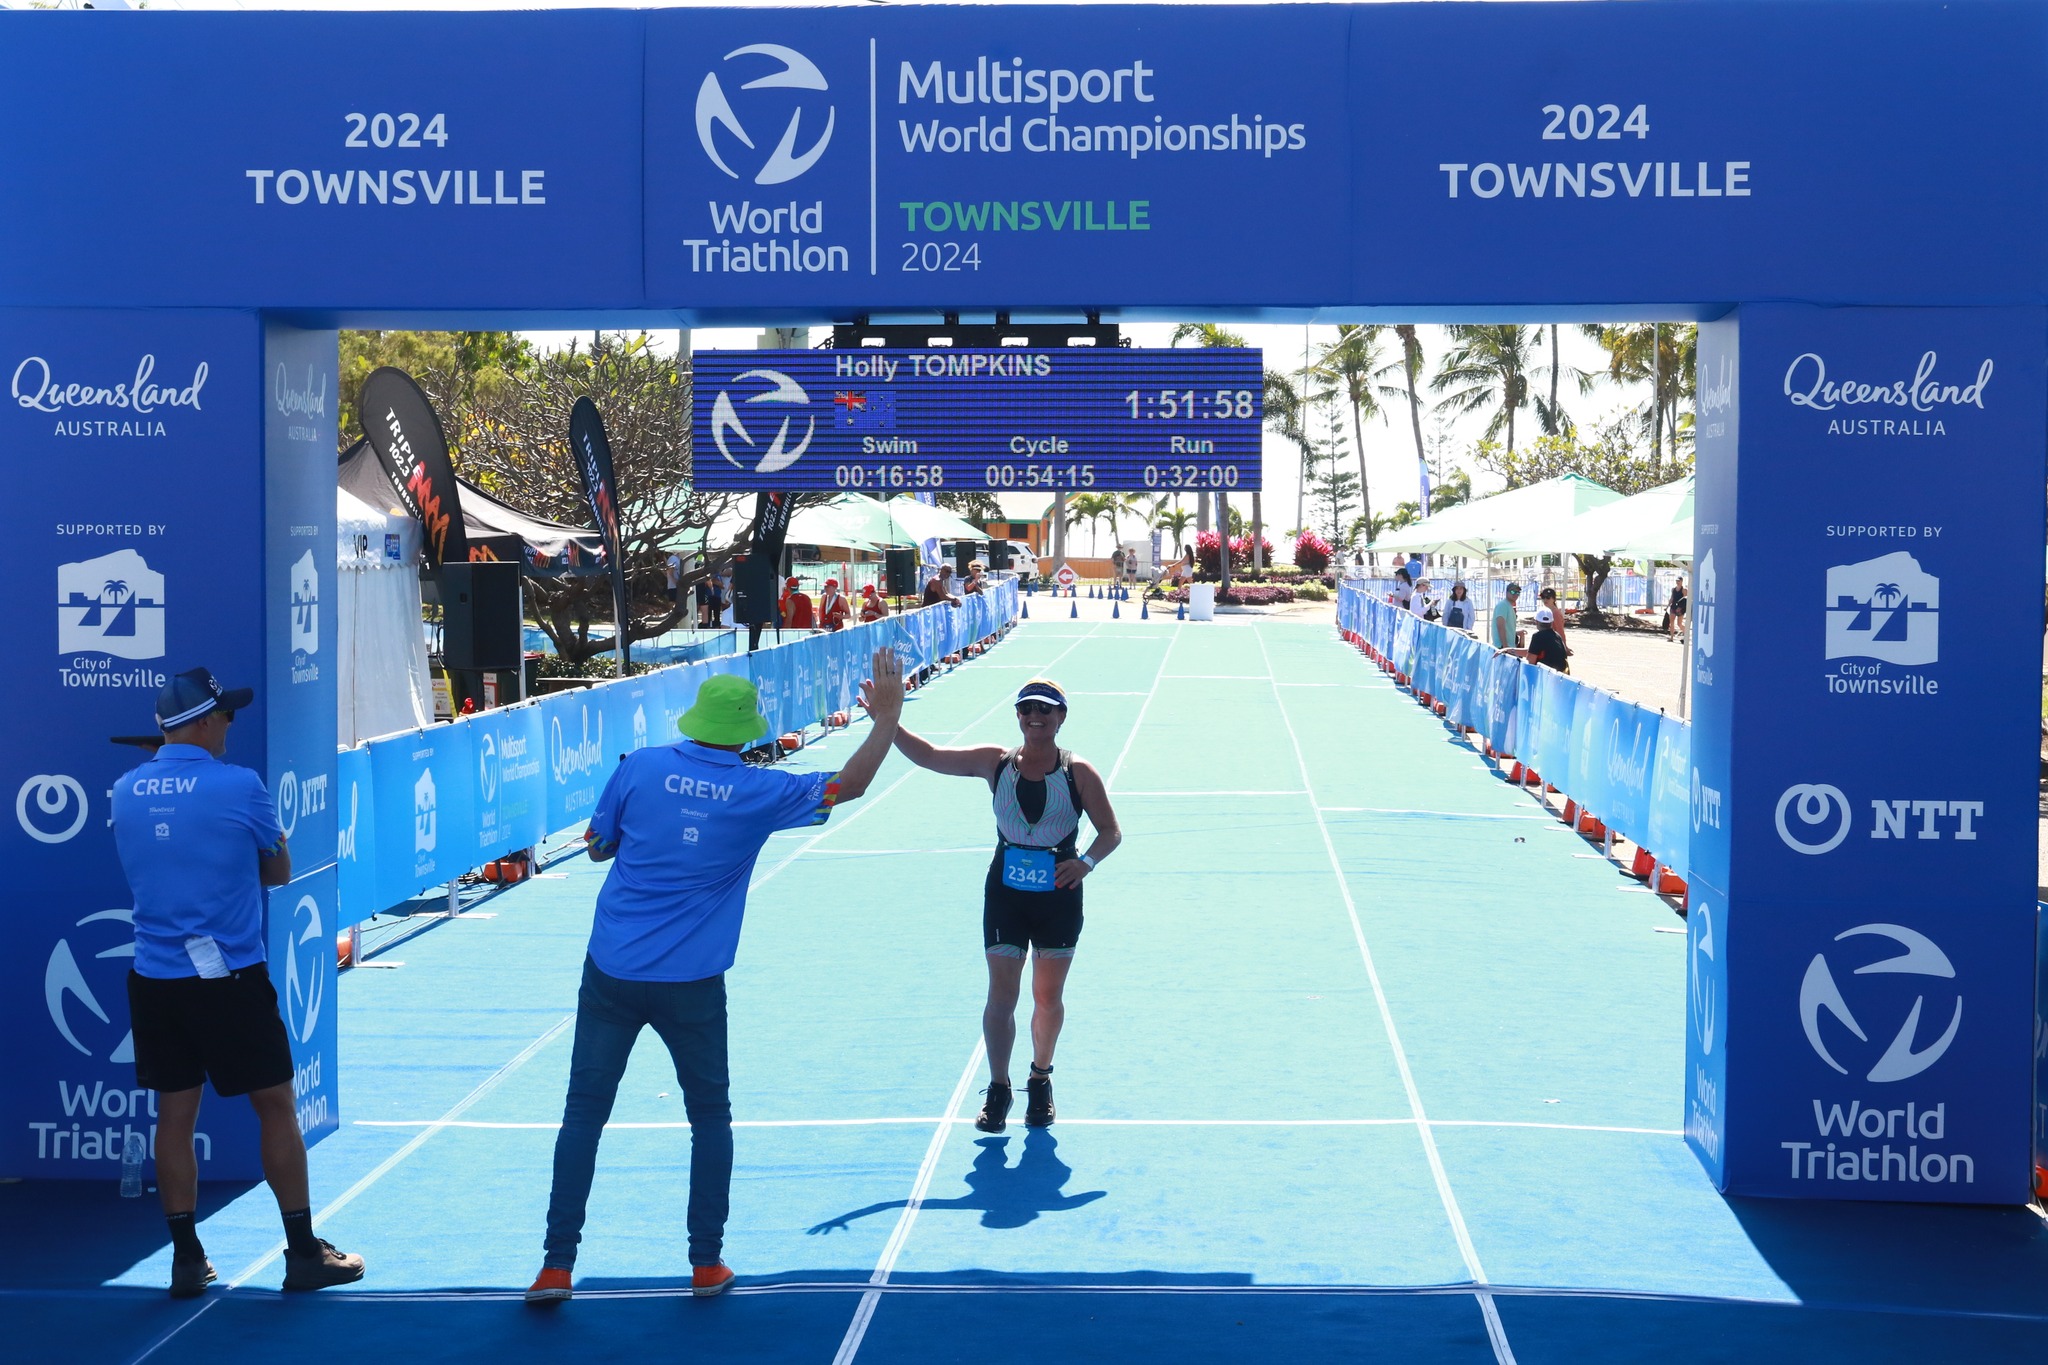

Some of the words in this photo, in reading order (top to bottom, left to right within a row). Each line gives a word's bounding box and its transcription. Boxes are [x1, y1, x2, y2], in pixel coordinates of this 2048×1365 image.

[898, 56, 1155, 113] Multisport
[344, 112, 448, 148] 2024
[899, 117, 1012, 154] World
[1022, 113, 1306, 160] Championships
[1542, 104, 1649, 140] 2024
[246, 169, 546, 206] TOWNSVILLE
[1439, 161, 1751, 199] TOWNSVILLE
[709, 200, 822, 235] World
[900, 200, 1151, 232] TOWNSVILLE
[683, 238, 849, 273] Triathlon
[901, 242, 982, 272] 2024
[835, 354, 898, 383] Holly
[908, 354, 1051, 377] TOMPKINS
[1783, 350, 1994, 413] Queensland
[11, 353, 209, 415] Queensland
[275, 362, 327, 420] Queensland
[1700, 354, 1733, 417] Queensland
[1125, 390, 1254, 420] 1:51:58
[54, 420, 167, 437] AUSTRALIA
[288, 425, 317, 441] AUSTRALIA
[1827, 420, 1947, 437] AUSTRALIA
[386, 407, 424, 481] TRIPLE
[862, 436, 918, 455] Swim
[1010, 436, 1069, 459] Cycle
[1170, 436, 1214, 455] Run
[388, 443, 410, 478] 102.3
[835, 465, 943, 488] 00:16:58
[985, 465, 1095, 488] 00:54:15
[1144, 465, 1239, 488] 0:32:00
[56, 524, 142, 536] SUPPORTED
[148, 524, 166, 535] BY
[290, 525, 313, 537] SUPPORTED
[313, 525, 319, 535] BY
[1826, 525, 1917, 537] SUPPORTED
[1924, 526, 1943, 537] BY
[354, 534, 368, 559] VIP
[59, 668, 166, 688] Townsville
[73, 657, 97, 672] City
[98, 657, 112, 669] of
[291, 663, 319, 685] Townsville
[1840, 663, 1865, 678] City
[1867, 663, 1881, 676] of
[1825, 674, 1939, 695] Townsville
[501, 733, 527, 761] Multisport
[551, 704, 603, 785] Queensland
[133, 777, 198, 796] CREW
[301, 774, 328, 817] NTT
[565, 785, 595, 814] AUSTRALIA
[665, 774, 733, 802] CREW
[482, 809, 496, 828] World
[1701, 785, 1721, 830] NTT
[1870, 799, 1984, 841] NTT
[1008, 865, 1048, 884] 2342
[58, 1080, 158, 1118] Worl
[1696, 1063, 1717, 1117] World
[1691, 1099, 1718, 1164] Triathlon
[1812, 1099, 1945, 1141] World
[1781, 1141, 1974, 1184] Triathlon
